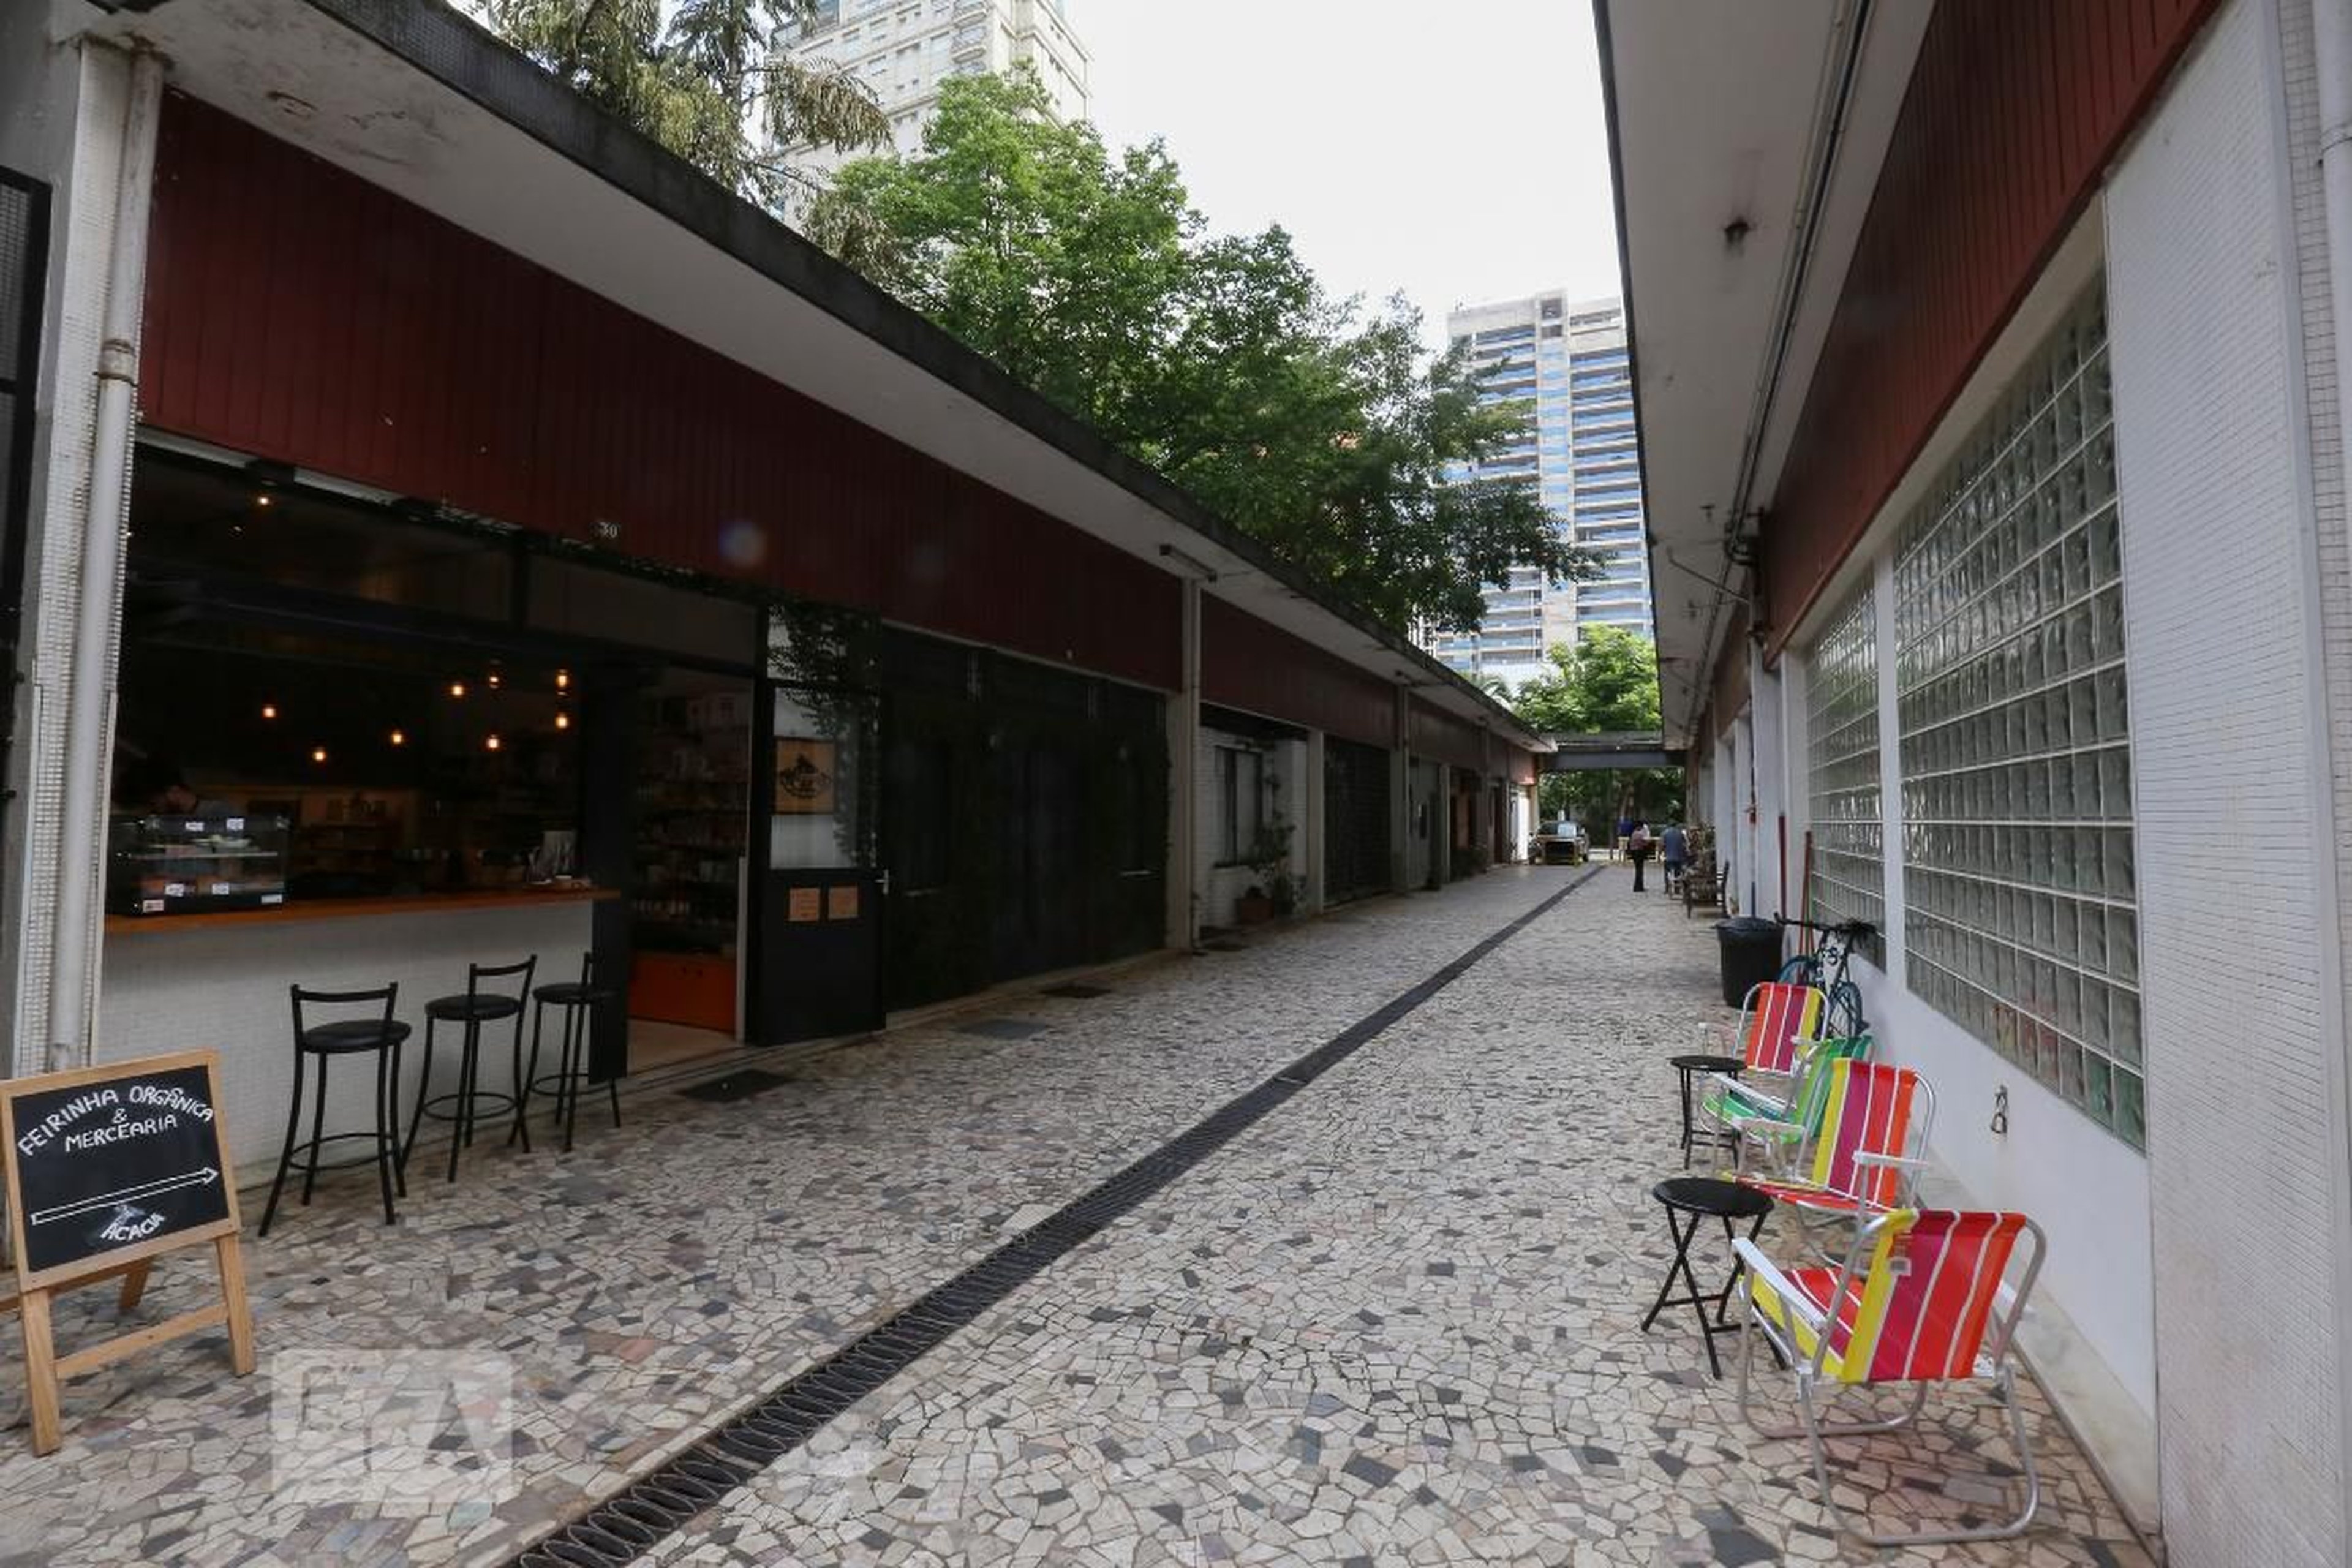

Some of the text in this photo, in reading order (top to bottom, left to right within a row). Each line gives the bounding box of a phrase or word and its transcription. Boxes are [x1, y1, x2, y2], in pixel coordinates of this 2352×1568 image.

[17, 1088, 119, 1156] FEIRINHA
[64, 1113, 178, 1153] MERCEARIA
[112, 1107, 128, 1124] &
